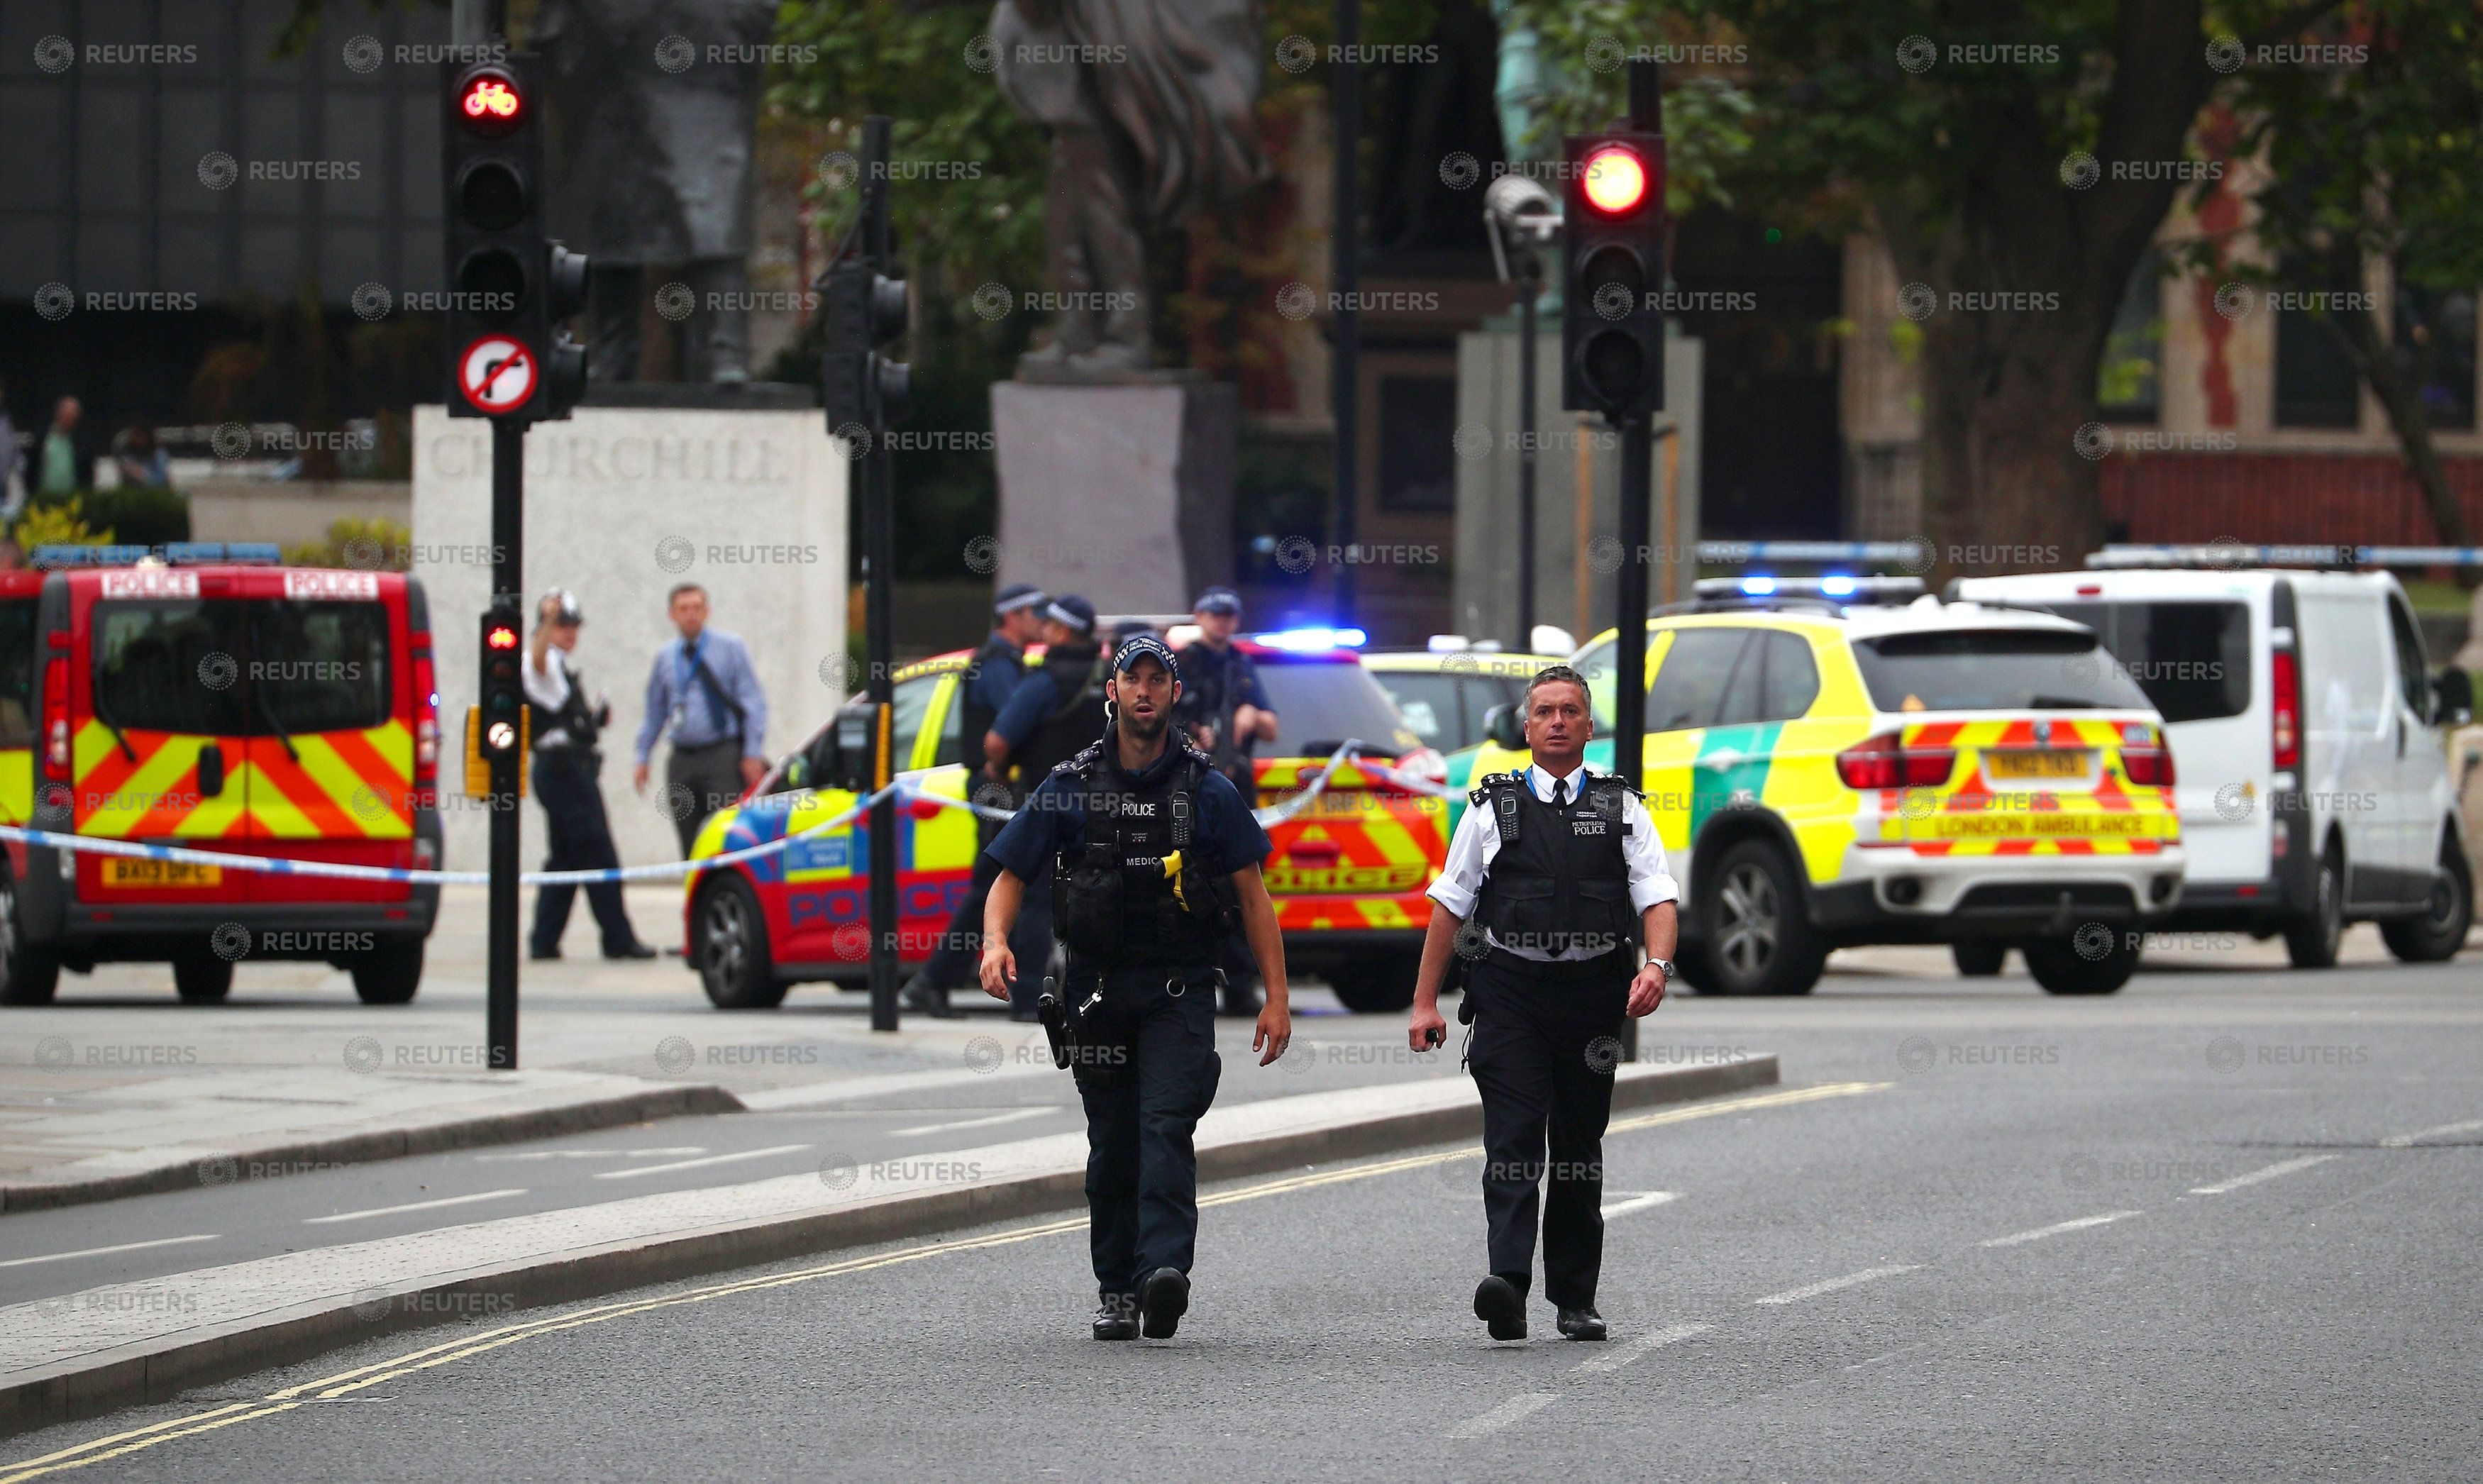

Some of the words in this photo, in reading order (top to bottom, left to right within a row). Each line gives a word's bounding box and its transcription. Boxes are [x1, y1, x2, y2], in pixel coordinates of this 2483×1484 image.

[109, 572, 192, 593] POLICE
[292, 572, 371, 593] POLICE
[1122, 803, 1156, 816] POLICE
[1574, 826, 1606, 836] POLICE
[1935, 816, 2023, 838] LONDON
[2032, 815, 2143, 835] AMBULANCE
[1127, 857, 1158, 866] MEDIC
[788, 879, 973, 929] POCE
